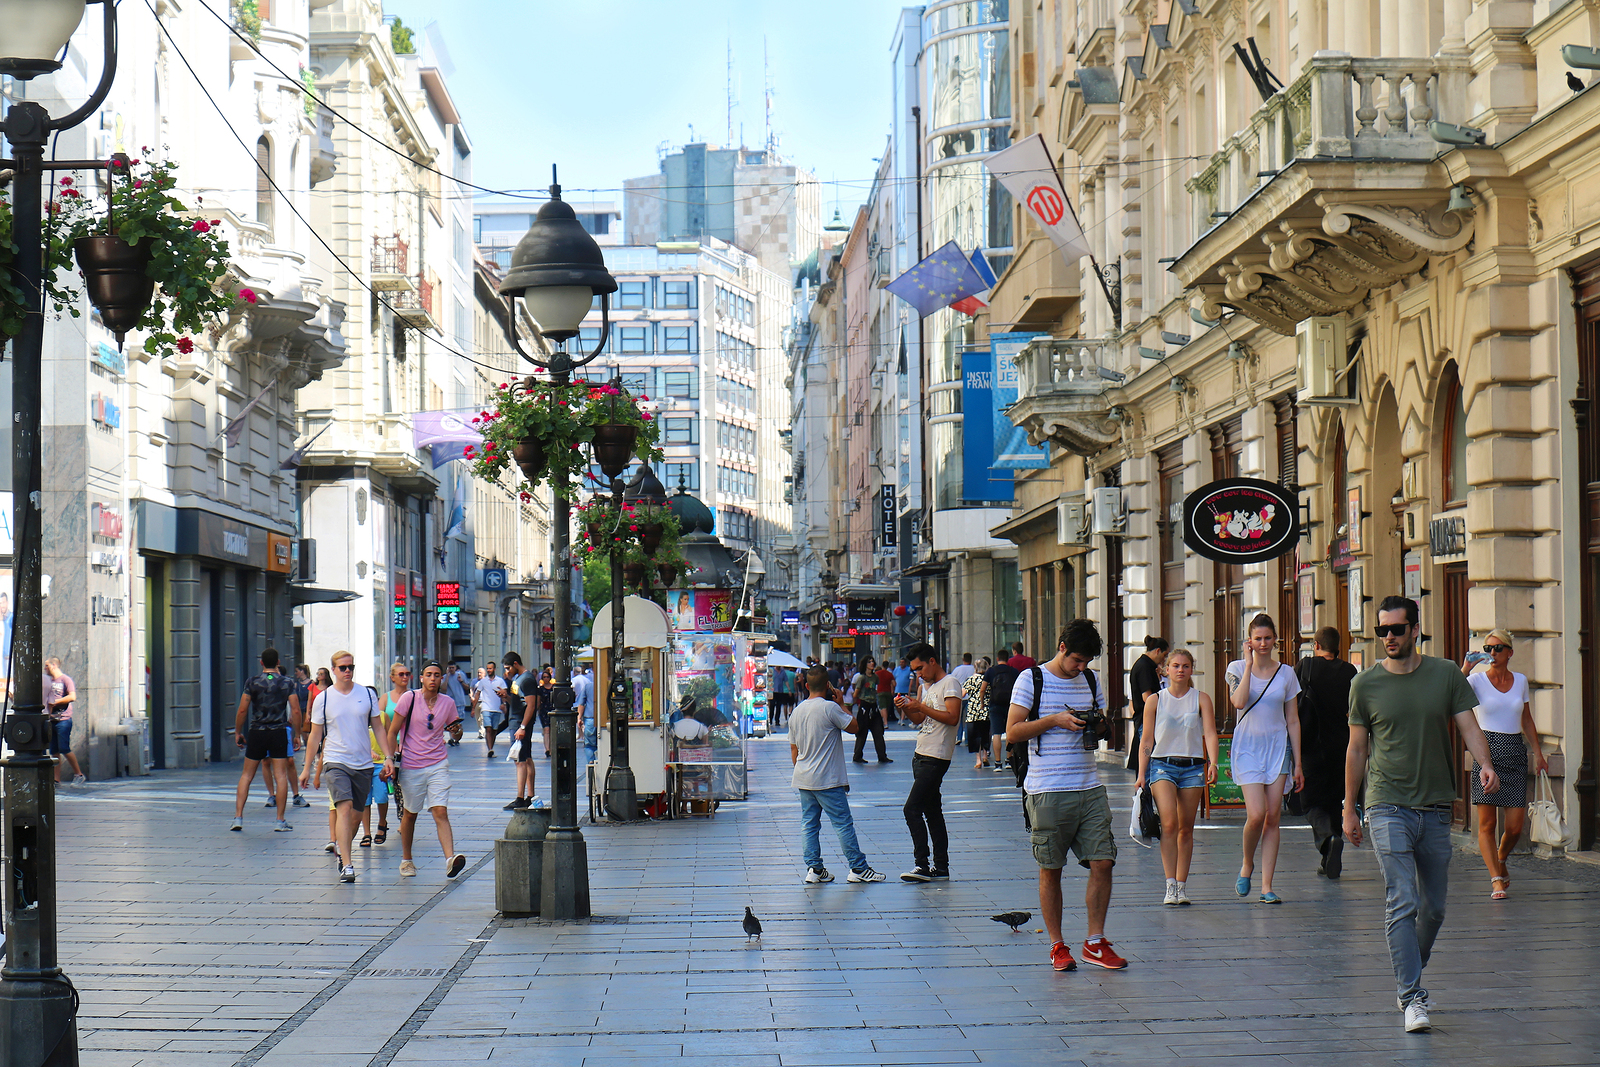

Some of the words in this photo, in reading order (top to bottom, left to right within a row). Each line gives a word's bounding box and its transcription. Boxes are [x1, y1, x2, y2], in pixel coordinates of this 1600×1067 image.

[1223, 490, 1240, 498] cow
[1254, 490, 1278, 504] cream
[883, 486, 893, 545] HOTEL
[438, 612, 448, 623] €
[449, 612, 458, 623] $
[698, 615, 717, 625] FLY
